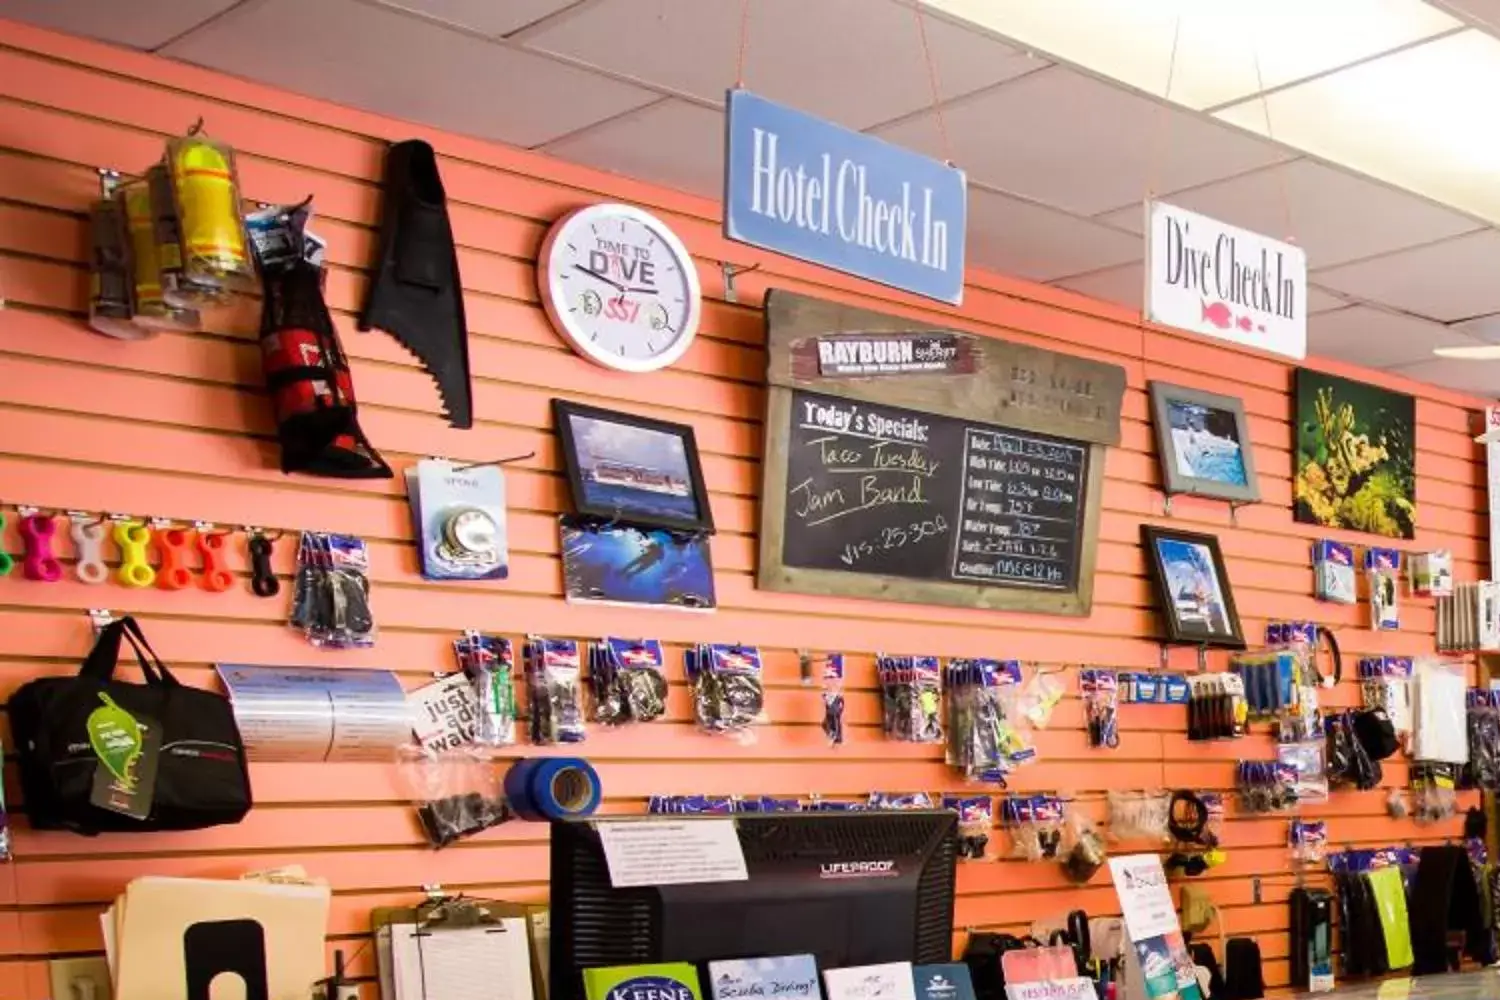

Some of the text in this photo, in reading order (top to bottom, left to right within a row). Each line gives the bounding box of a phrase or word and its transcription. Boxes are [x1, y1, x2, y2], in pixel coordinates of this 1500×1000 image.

[750, 128, 947, 272] Hotel Check In
[596, 237, 660, 260] TIME TO
[1166, 215, 1294, 320] Dive Check In
[604, 298, 650, 323] SSI
[818, 341, 912, 364] RAYBURN
[804, 402, 929, 442] Today's Specials:
[805, 436, 939, 477] Taco Tuesday
[790, 475, 928, 517] Jam Band
[424, 689, 470, 723] just
[720, 983, 764, 998] Scuba
